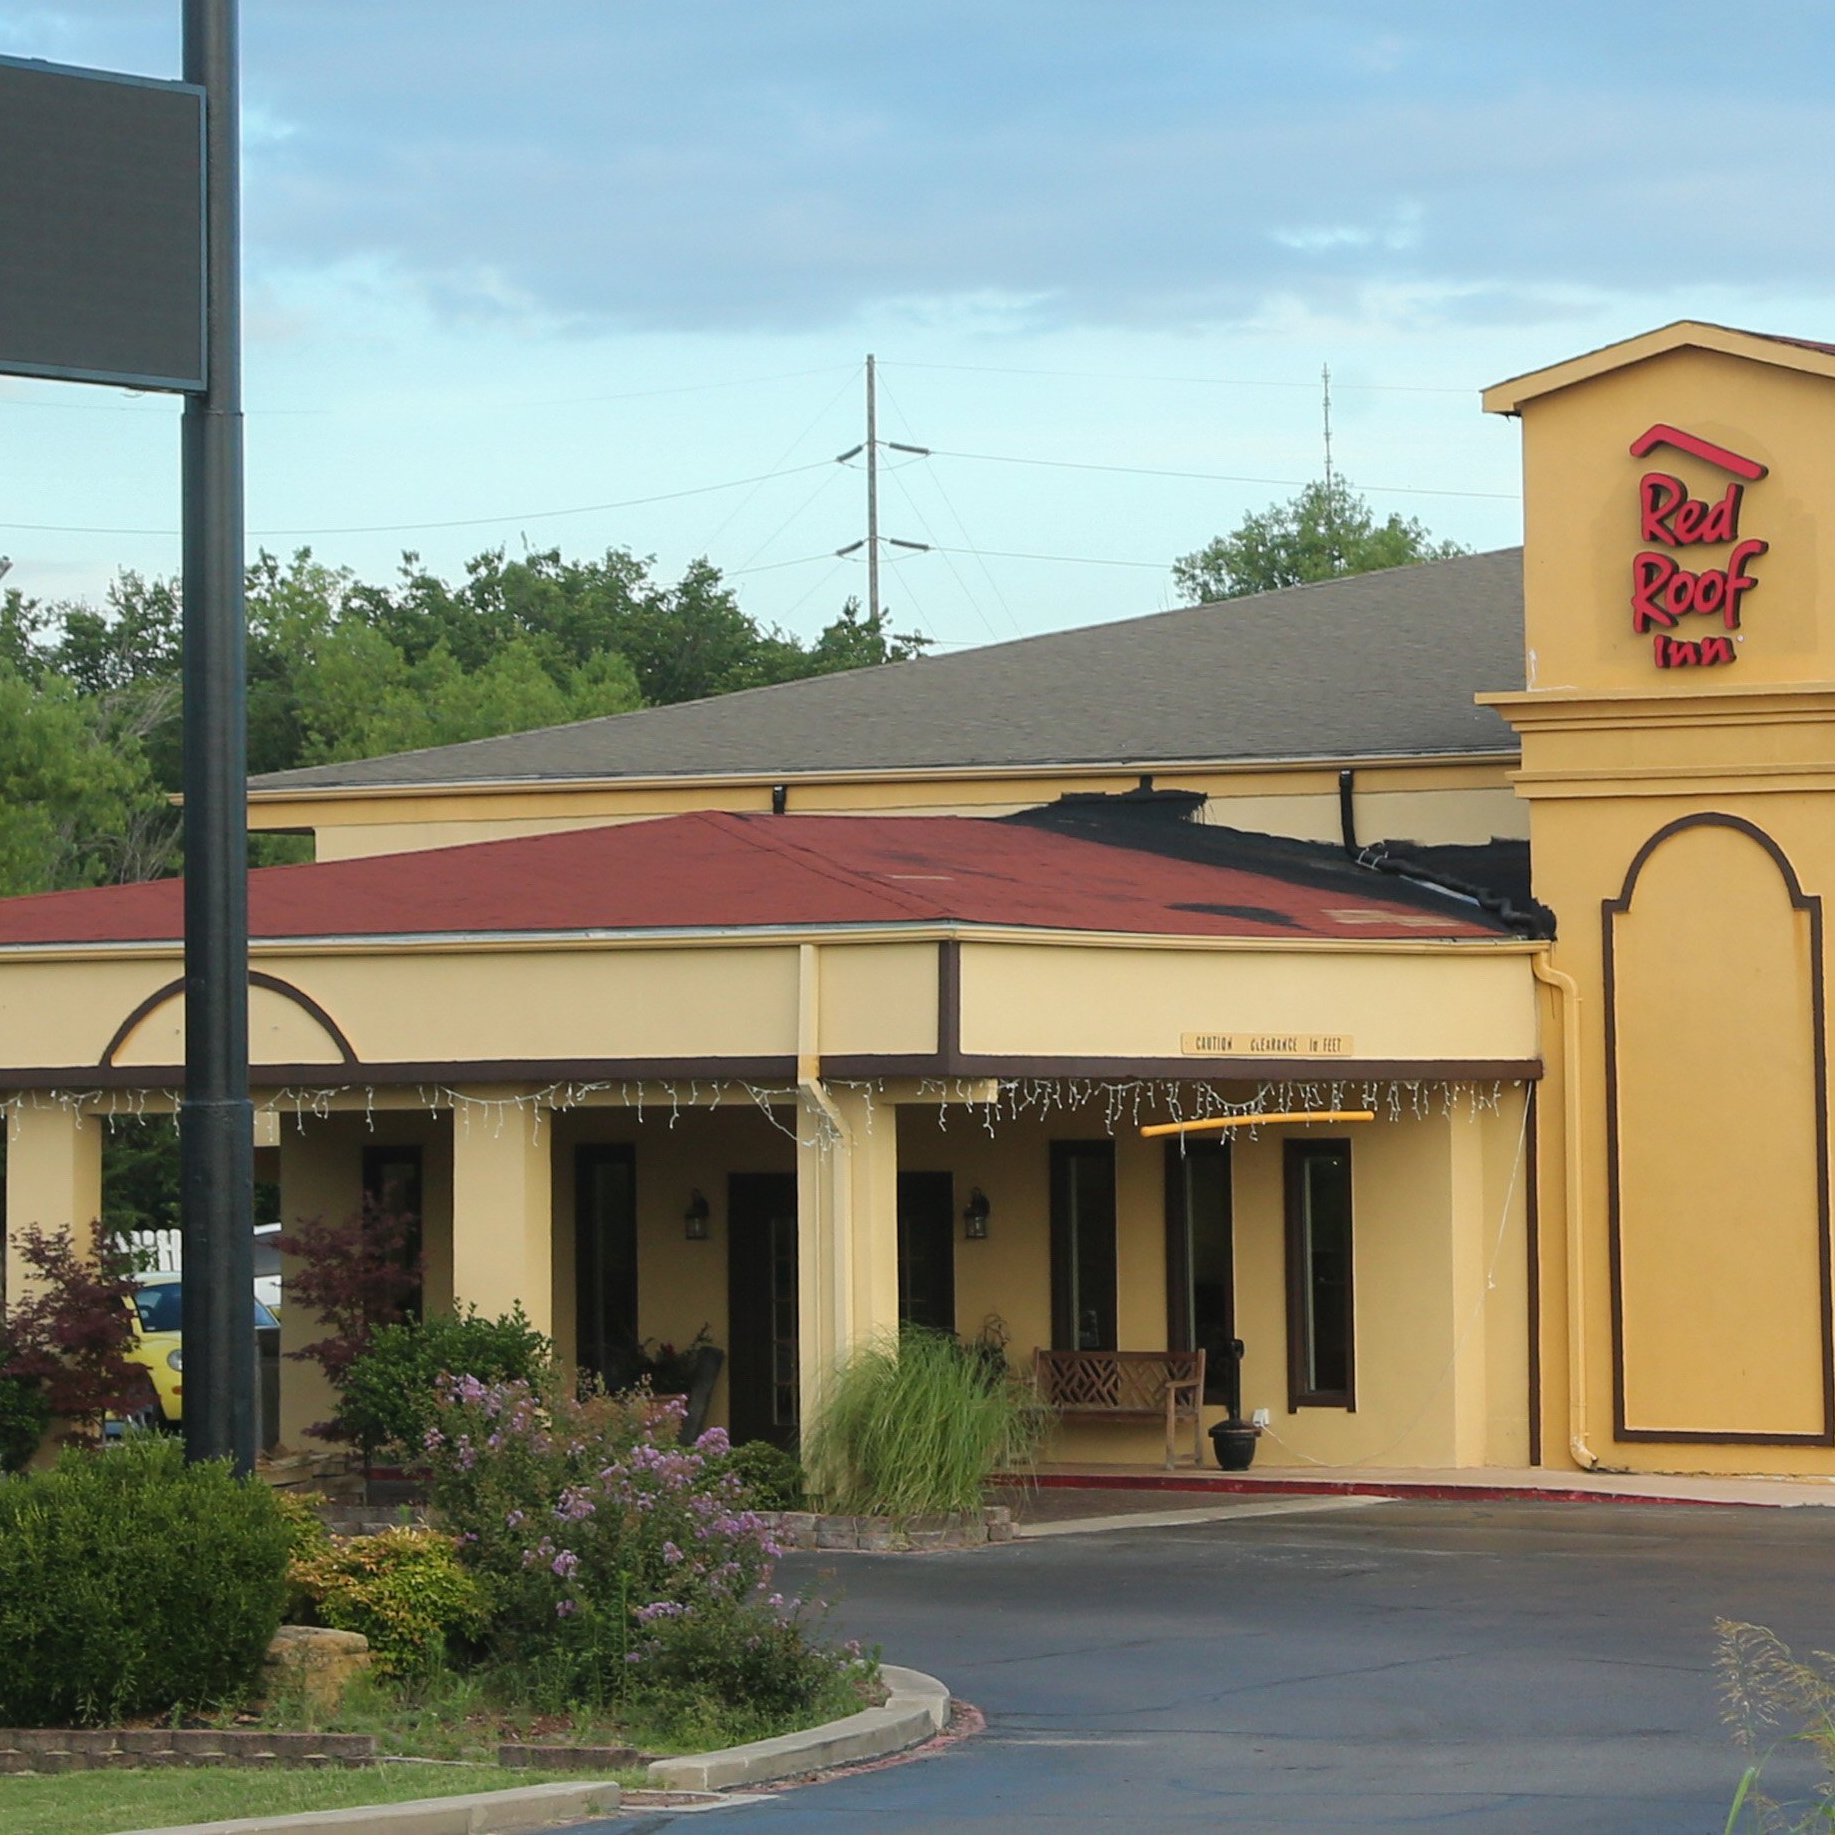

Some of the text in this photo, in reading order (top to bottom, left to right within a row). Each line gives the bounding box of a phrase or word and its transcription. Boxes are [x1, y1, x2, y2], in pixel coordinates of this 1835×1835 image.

[1640, 472, 1742, 546] Red
[1631, 539, 1768, 633] Roof
[1654, 634, 1736, 668] Inn
[1195, 1036, 1233, 1051] CAUTION
[1250, 1037, 1298, 1052] CLEARANCE
[1322, 1037, 1342, 1052] FEET
